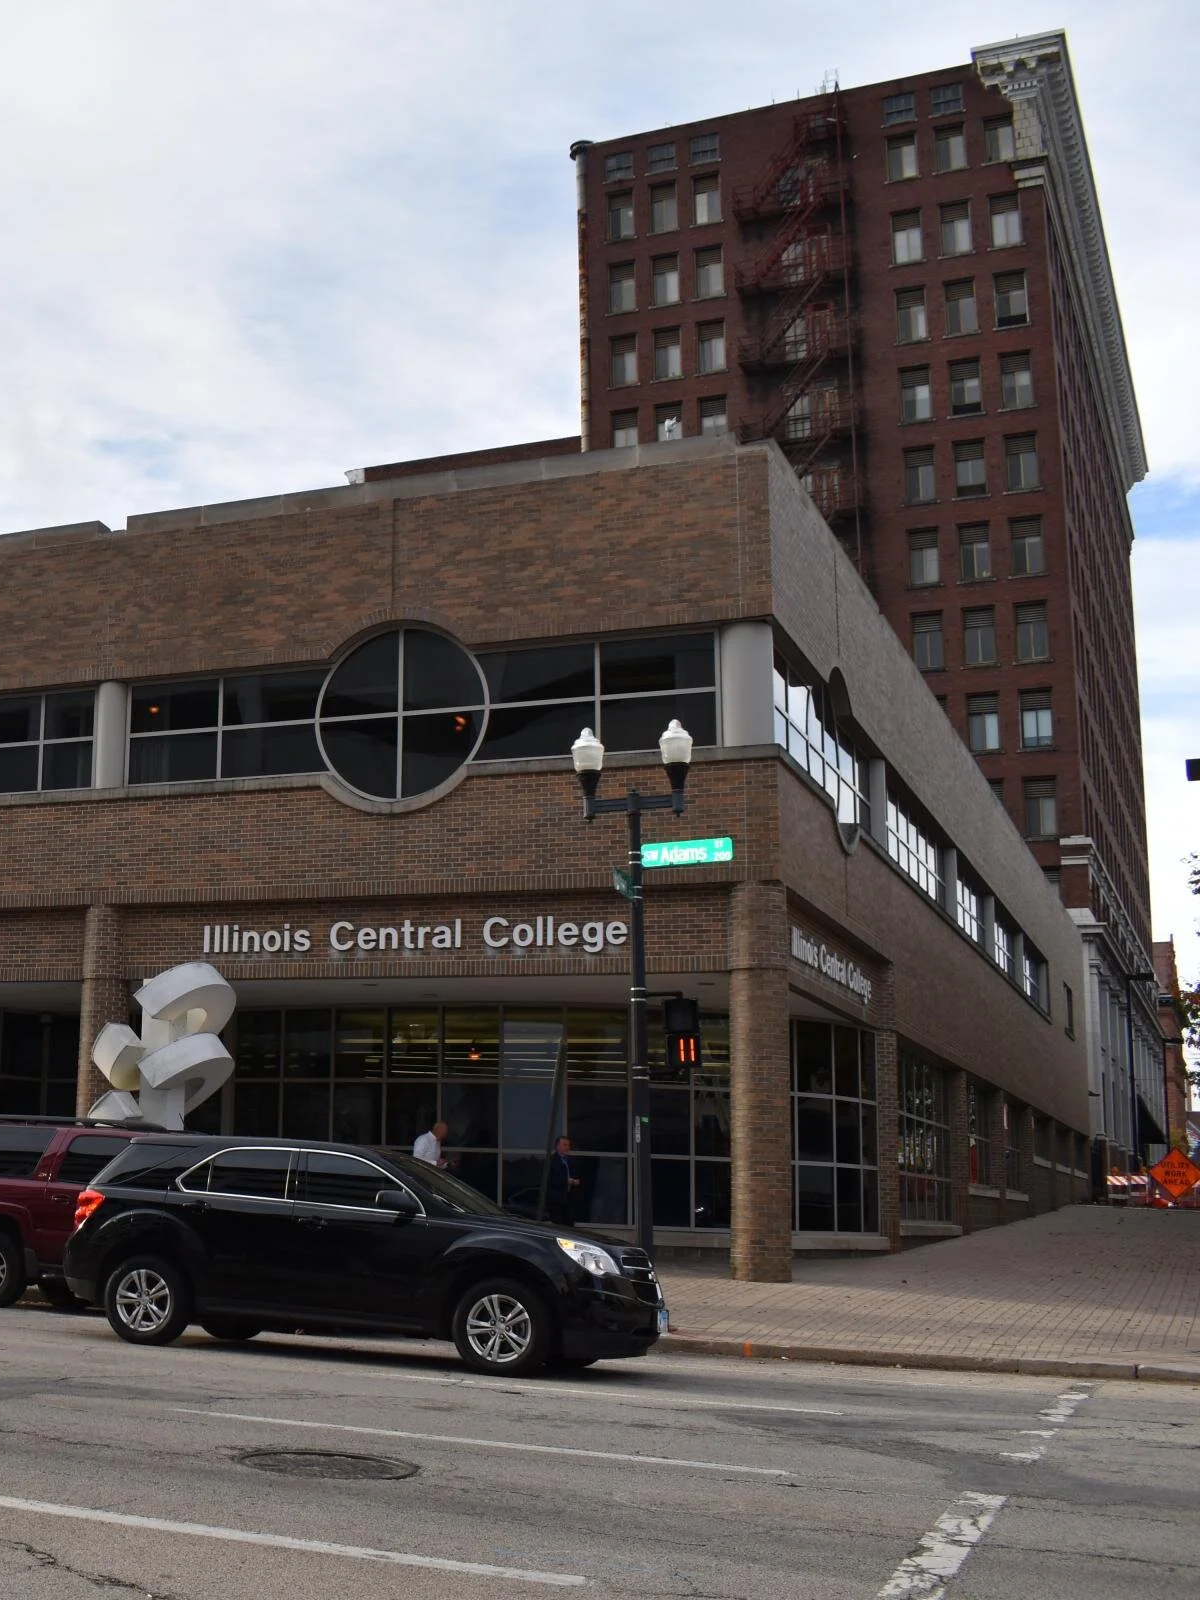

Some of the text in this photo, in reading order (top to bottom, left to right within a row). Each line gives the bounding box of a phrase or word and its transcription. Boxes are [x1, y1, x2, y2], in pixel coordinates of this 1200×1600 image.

[661, 846, 707, 863] Adams
[203, 916, 629, 954] Illinois Central College
[791, 926, 872, 1005] Illinois Central College
